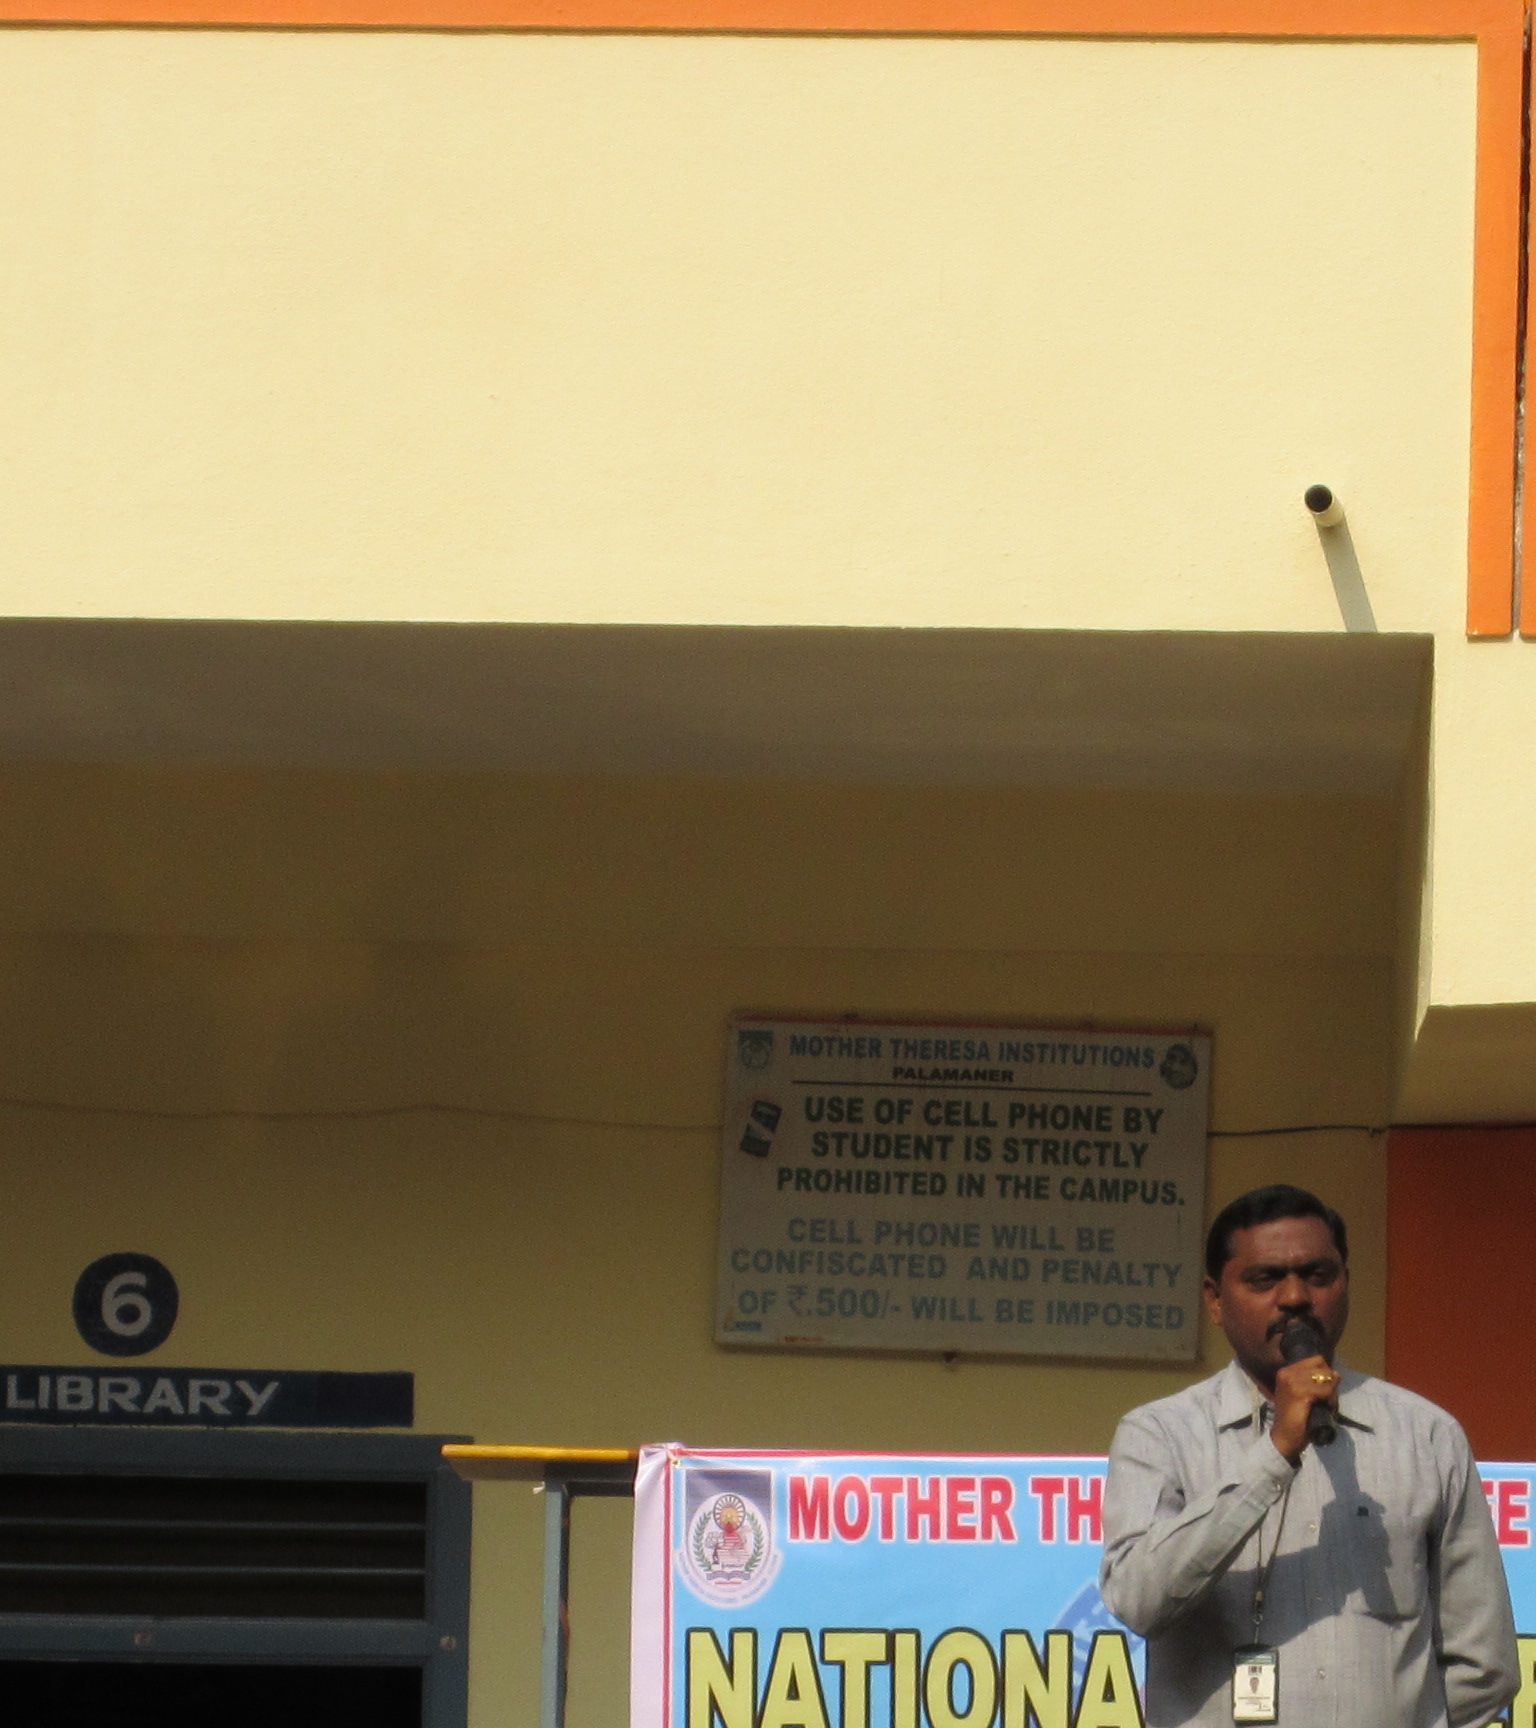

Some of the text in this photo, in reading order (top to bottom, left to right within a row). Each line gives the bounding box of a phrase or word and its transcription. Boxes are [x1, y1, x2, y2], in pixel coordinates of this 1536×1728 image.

[789, 1034, 1155, 1069] MOTHER THERESA INSTITUTIONS
[892, 1066, 1014, 1084] PALAMANER
[804, 1096, 1165, 1134] USE OF CELL PHONE BY
[811, 1131, 1150, 1168] STUDENT IS STRICTLY
[777, 1167, 1185, 1206] PROHIBITED IN THE CAMPUS.
[787, 1218, 1115, 1253] CELL PHONE WILL BE
[731, 1249, 1183, 1289] CONFISCATED AND PENALTY
[102, 1270, 153, 1338] 6
[738, 1289, 777, 1315] OF
[911, 1295, 984, 1323] WILL
[995, 1298, 1034, 1325] BE
[1046, 1301, 1185, 1331] IMPOSED
[7, 1374, 280, 1416] LIBRARY
[788, 1476, 1017, 1542] MOTHER
